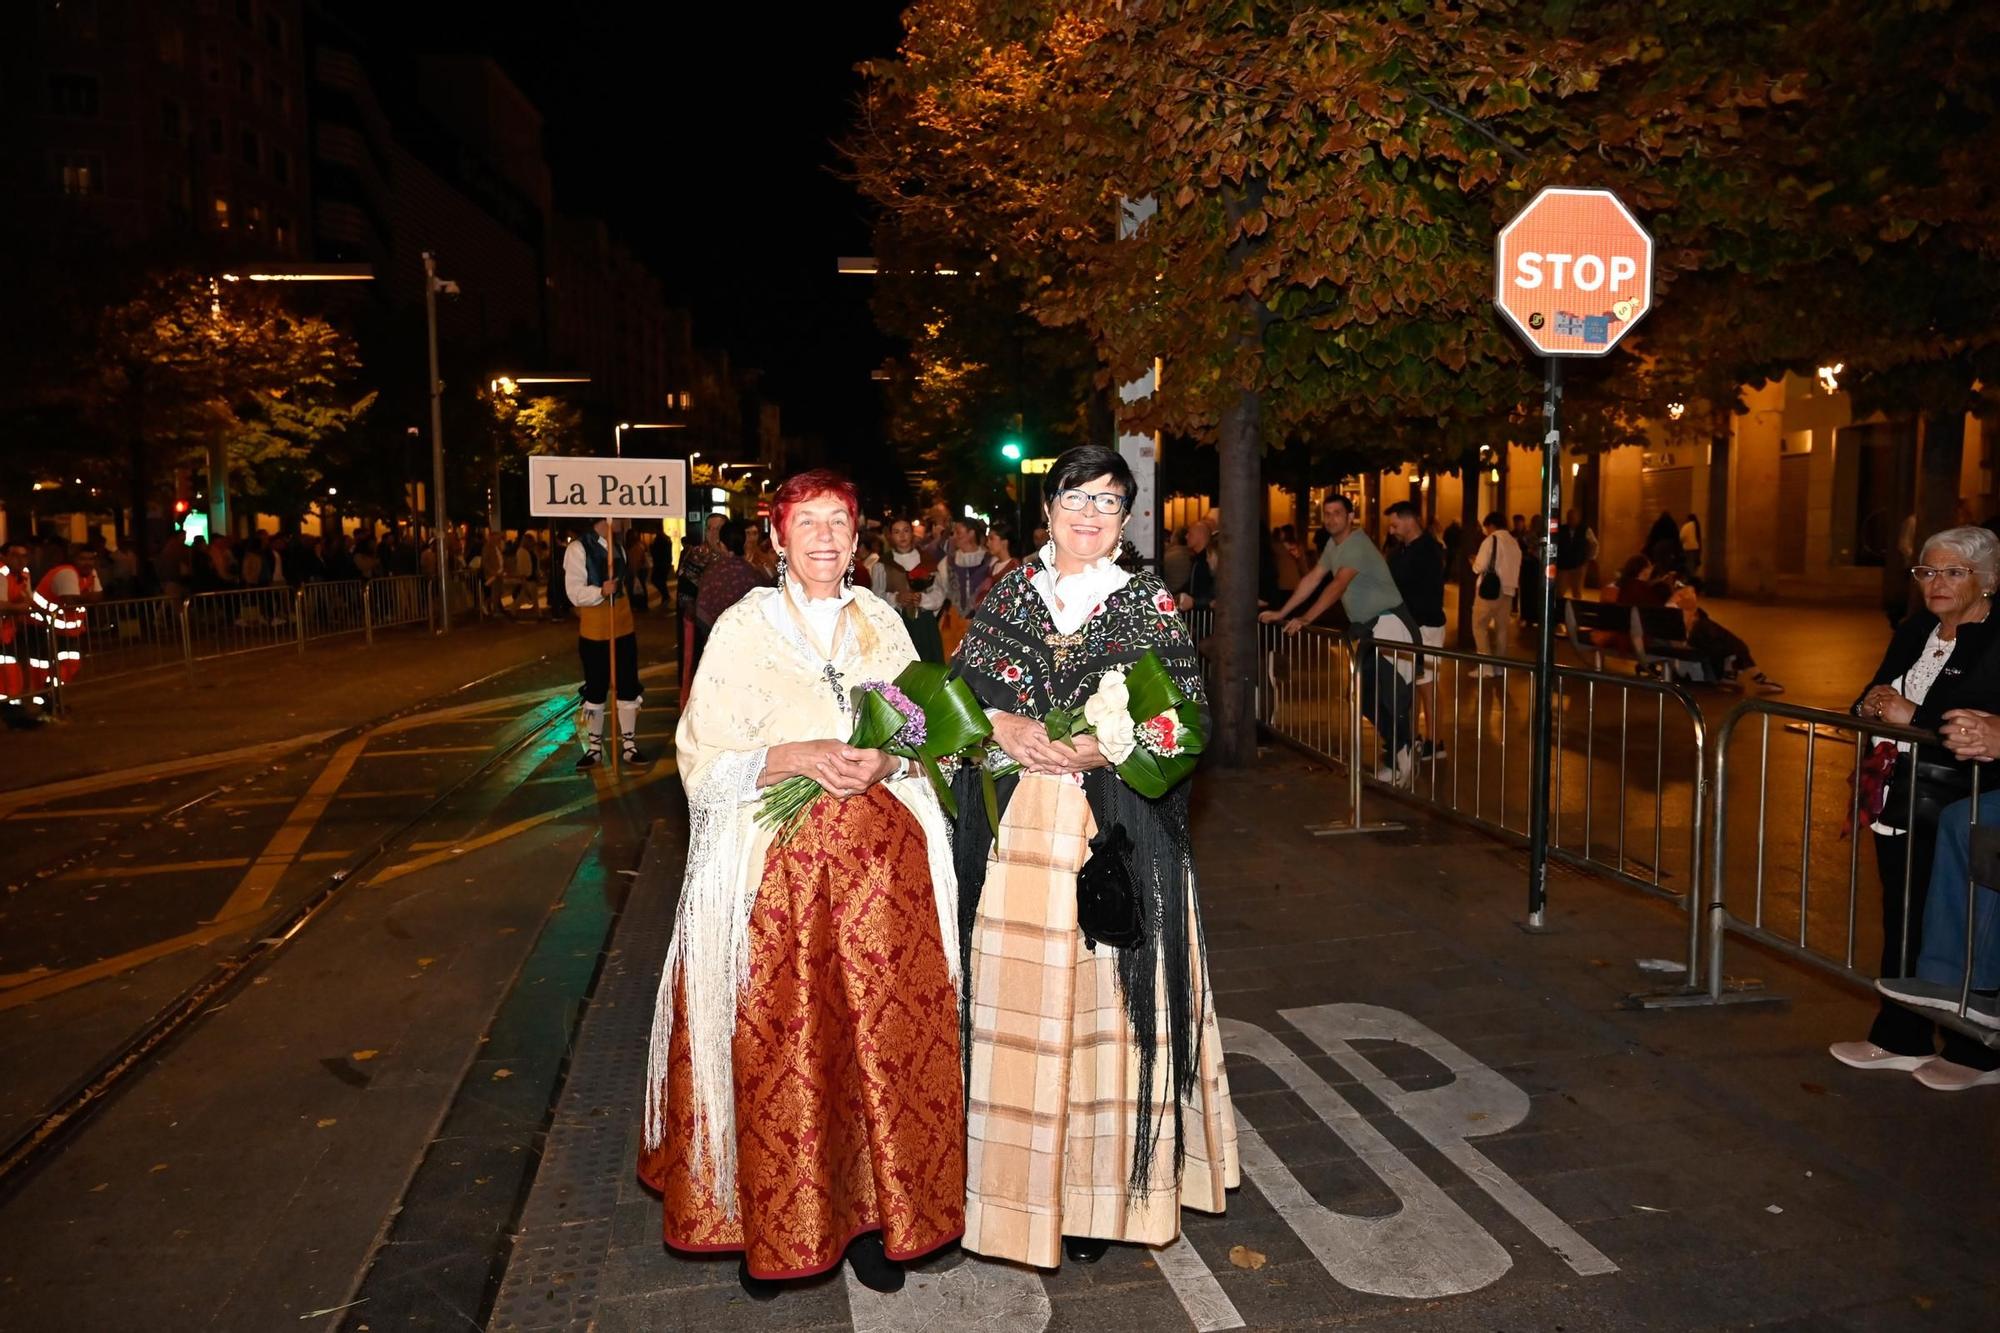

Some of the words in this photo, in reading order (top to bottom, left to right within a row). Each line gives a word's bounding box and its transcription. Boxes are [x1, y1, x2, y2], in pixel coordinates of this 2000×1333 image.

[1514, 252, 1636, 292] STOP
[545, 474, 587, 505] La
[597, 474, 669, 507] Paúl
